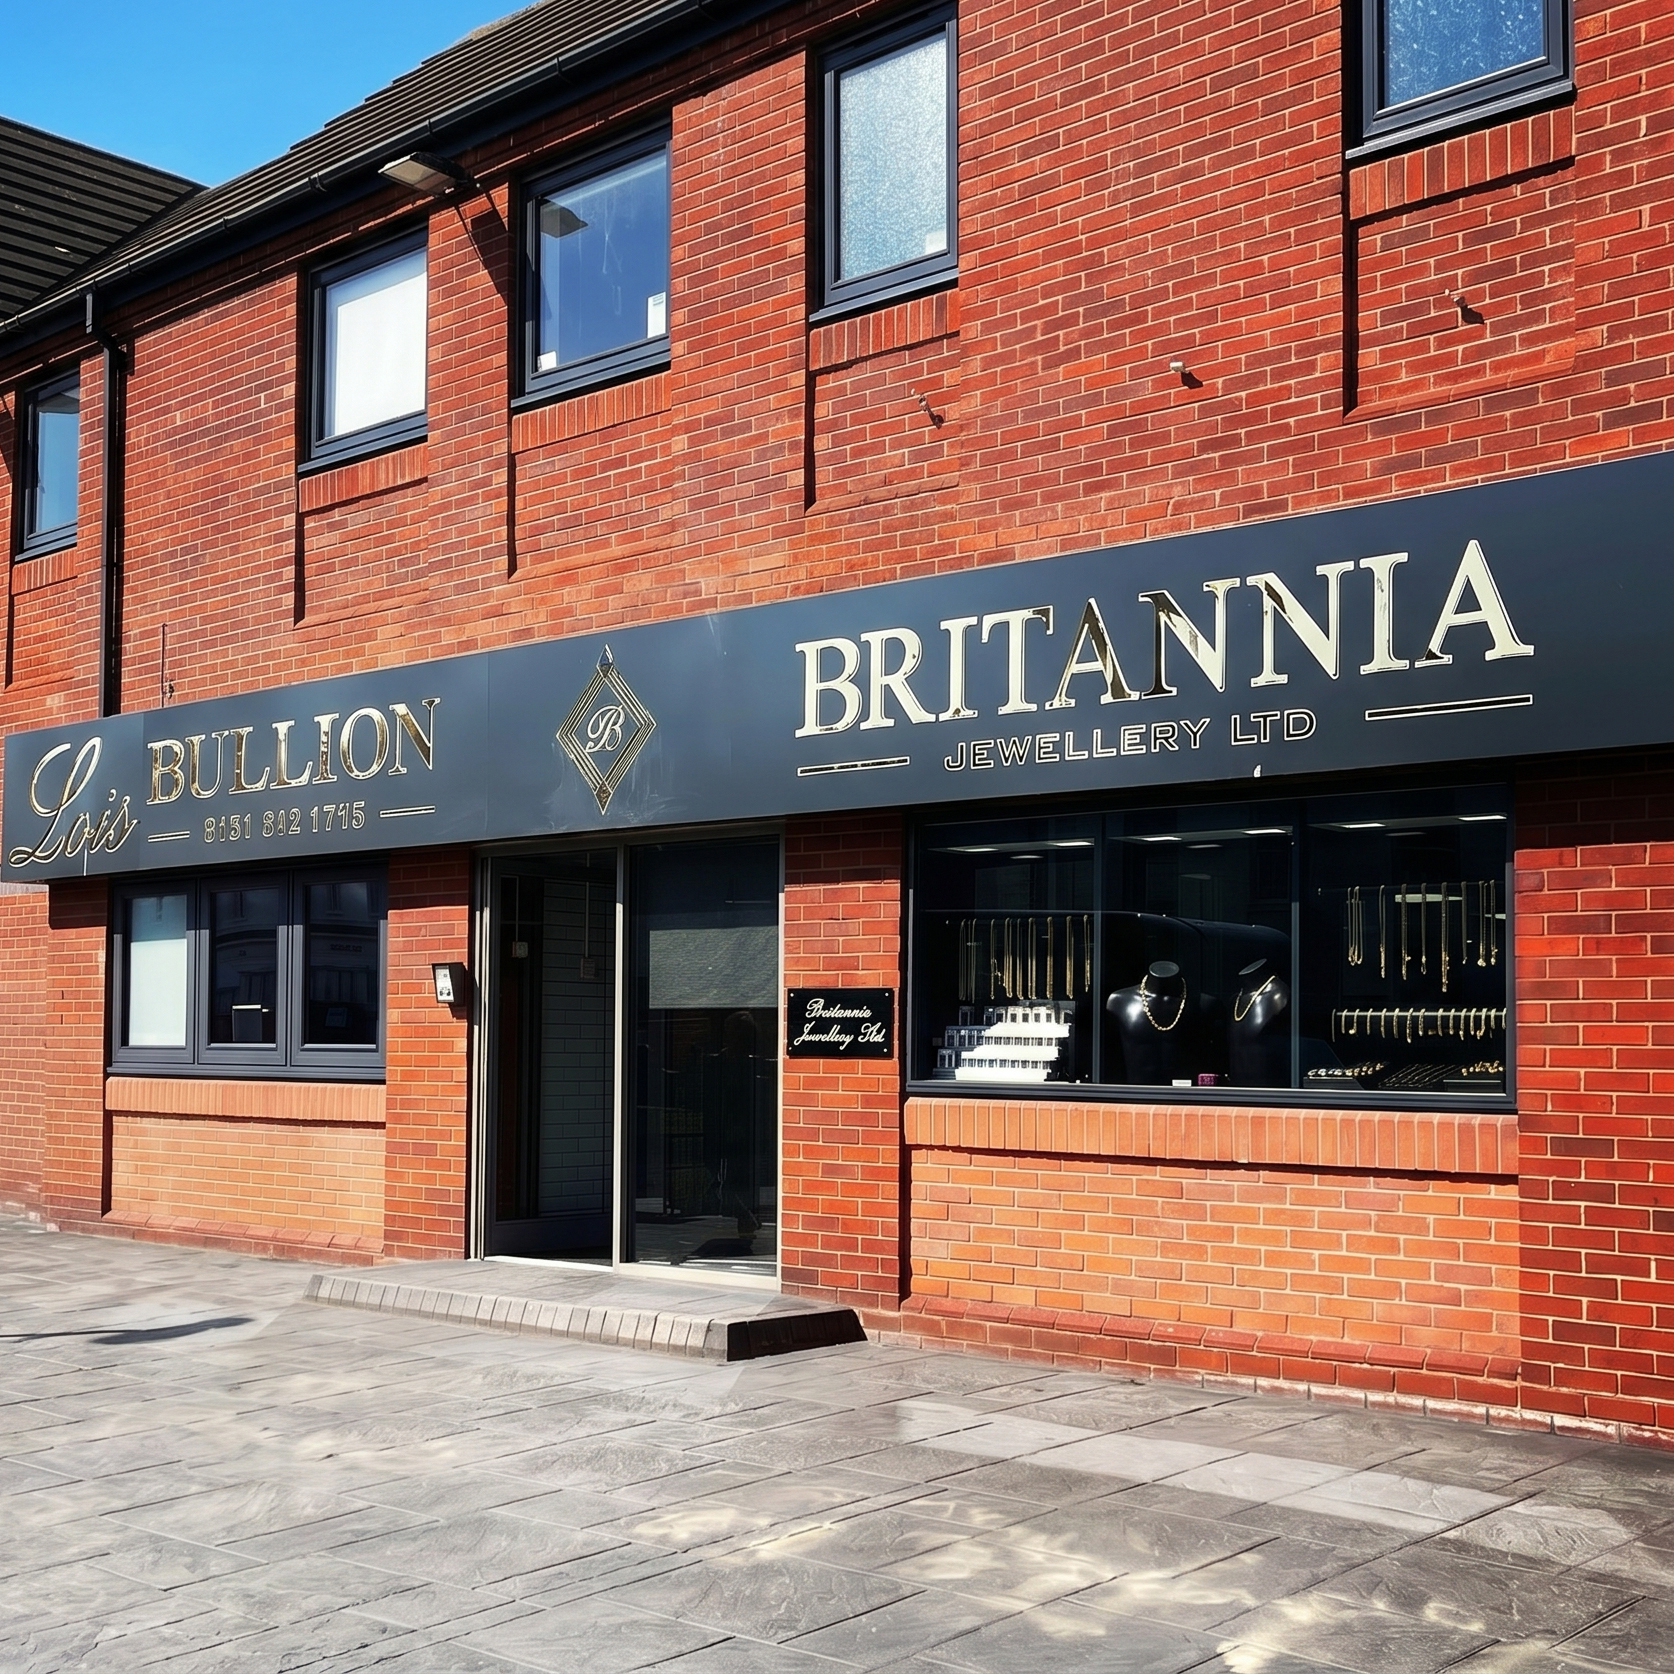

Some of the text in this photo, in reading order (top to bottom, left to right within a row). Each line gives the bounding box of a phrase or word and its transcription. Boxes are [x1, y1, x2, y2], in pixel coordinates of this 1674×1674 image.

[794, 539, 1535, 738] BRITANNIA
[146, 697, 441, 804] BULLION
[585, 704, 626, 753] B
[944, 708, 1317, 771] JEWELLERY LTD
